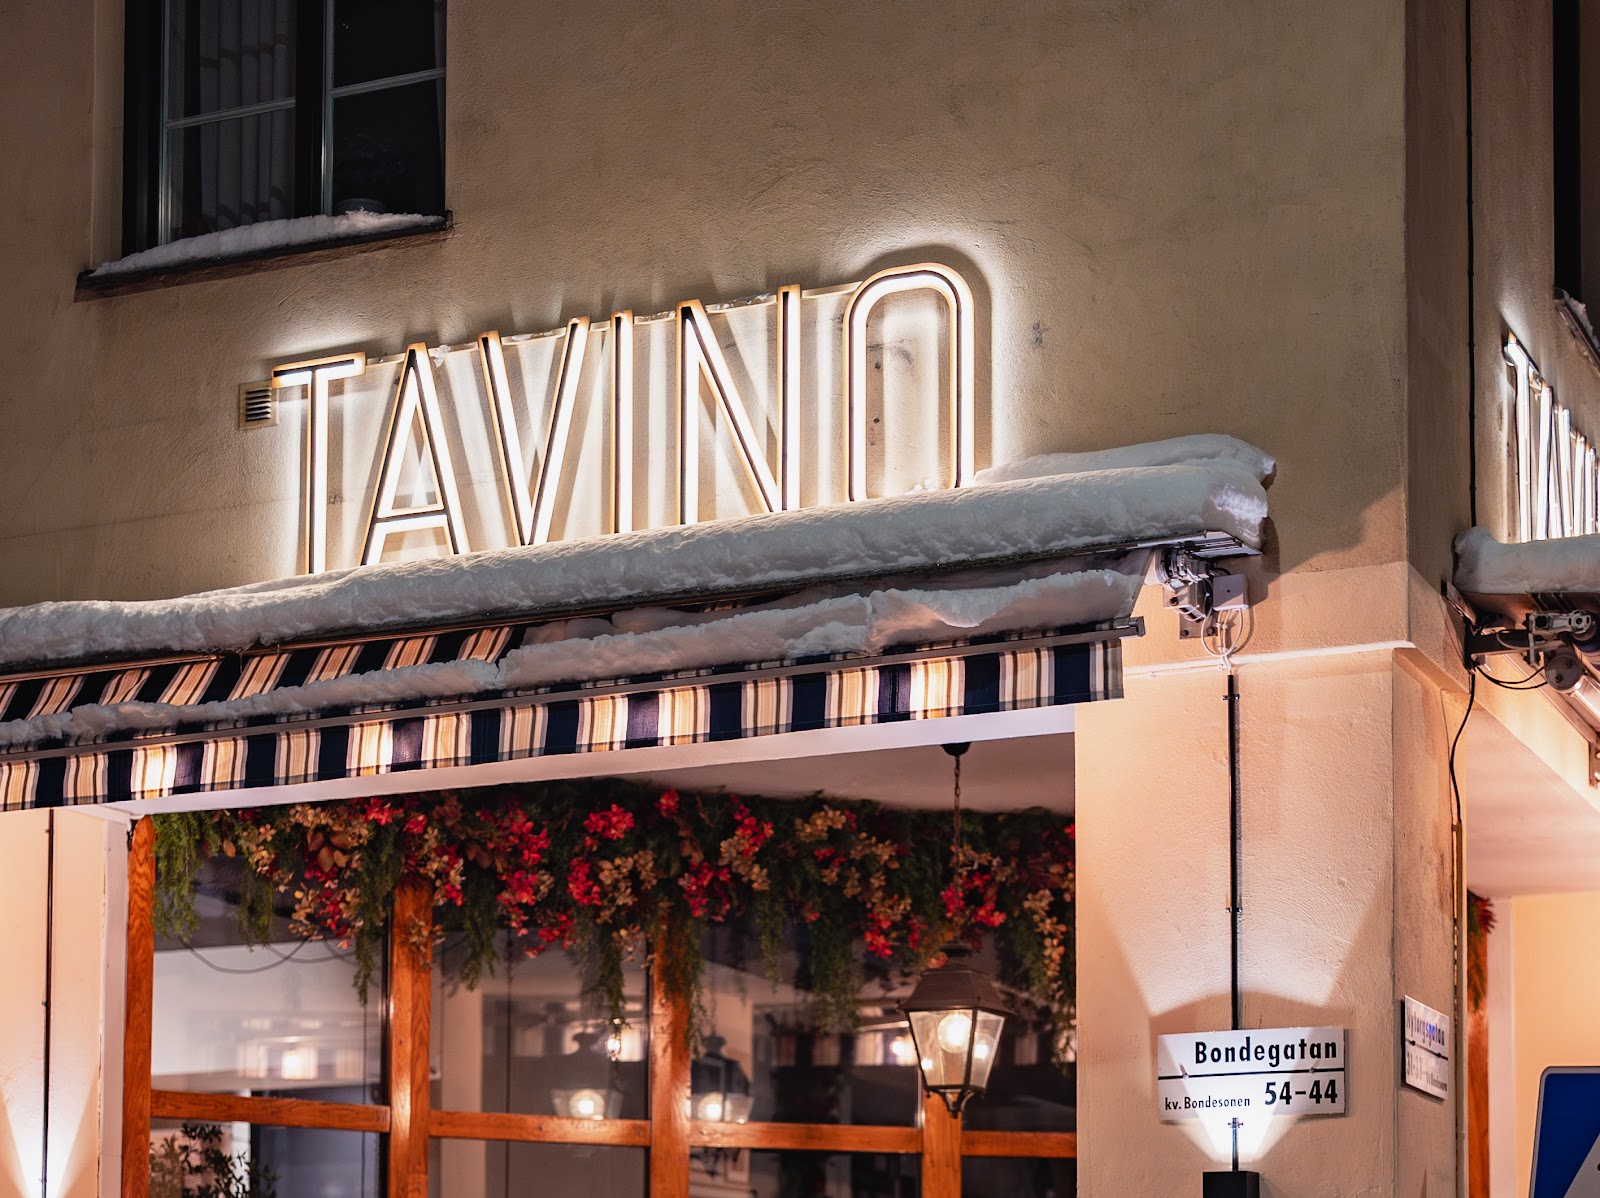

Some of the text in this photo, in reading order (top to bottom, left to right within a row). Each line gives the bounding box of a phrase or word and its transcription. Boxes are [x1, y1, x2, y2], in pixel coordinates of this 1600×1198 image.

[272, 262, 976, 575] TAVINO
[1195, 1036, 1337, 1067] Bondegatan
[1184, 1095, 1250, 1109] Bondesonen
[1264, 1079, 1338, 1105] 54-44
